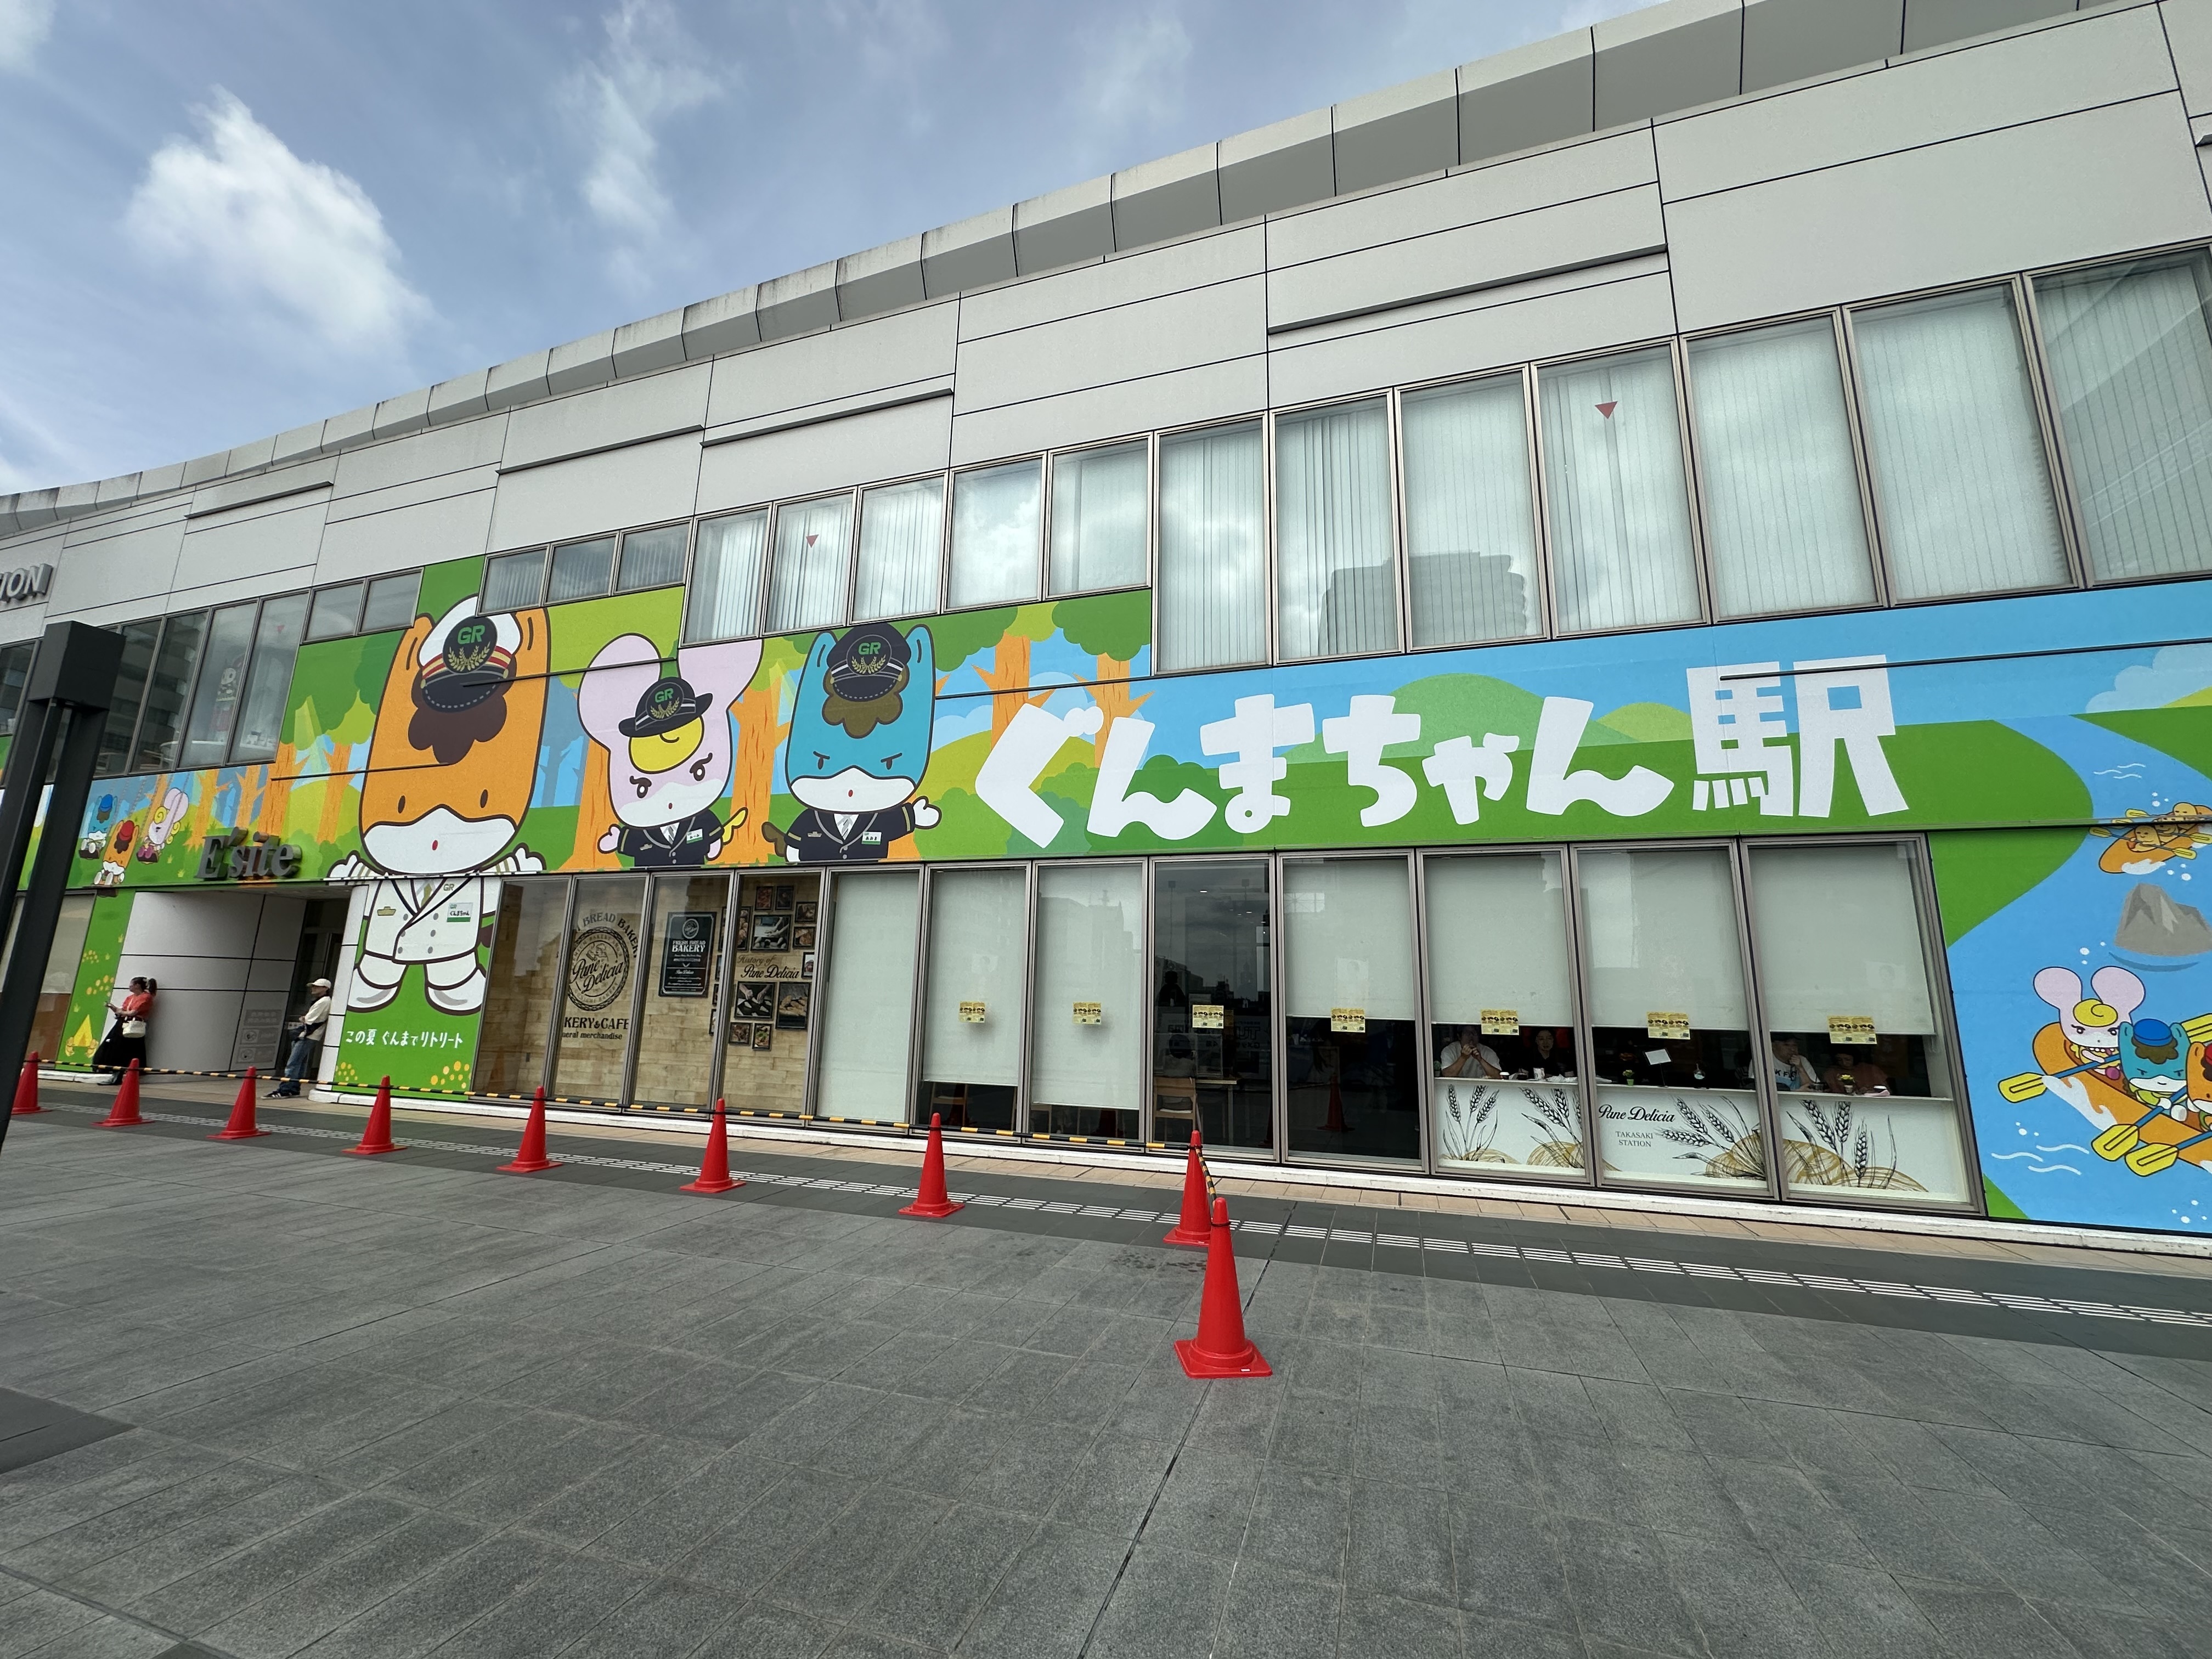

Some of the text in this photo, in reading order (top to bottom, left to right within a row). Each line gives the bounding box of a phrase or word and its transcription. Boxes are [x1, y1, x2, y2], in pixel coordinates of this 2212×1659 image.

[0, 563, 53, 603] ION
[458, 625, 486, 645] GR
[858, 642, 881, 655] GR
[654, 687, 674, 703] GR
[975, 654, 1910, 849] ぐんまちゃん駅
[194, 826, 301, 881] E'site
[583, 912, 616, 927] BREAD
[618, 918, 638, 958] BAKER
[737, 955, 777, 966] History of
[569, 958, 600, 984] Pane
[581, 961, 624, 994] Delicia
[741, 964, 799, 979] Pane Delicia
[564, 1017, 629, 1030] KERY&CAFE
[346, 1029, 463, 1048] この夏 ぐんまでリトリート
[1598, 1104, 1675, 1122] Pane Delicia
[1615, 1131, 1653, 1139] TAKASAKI
